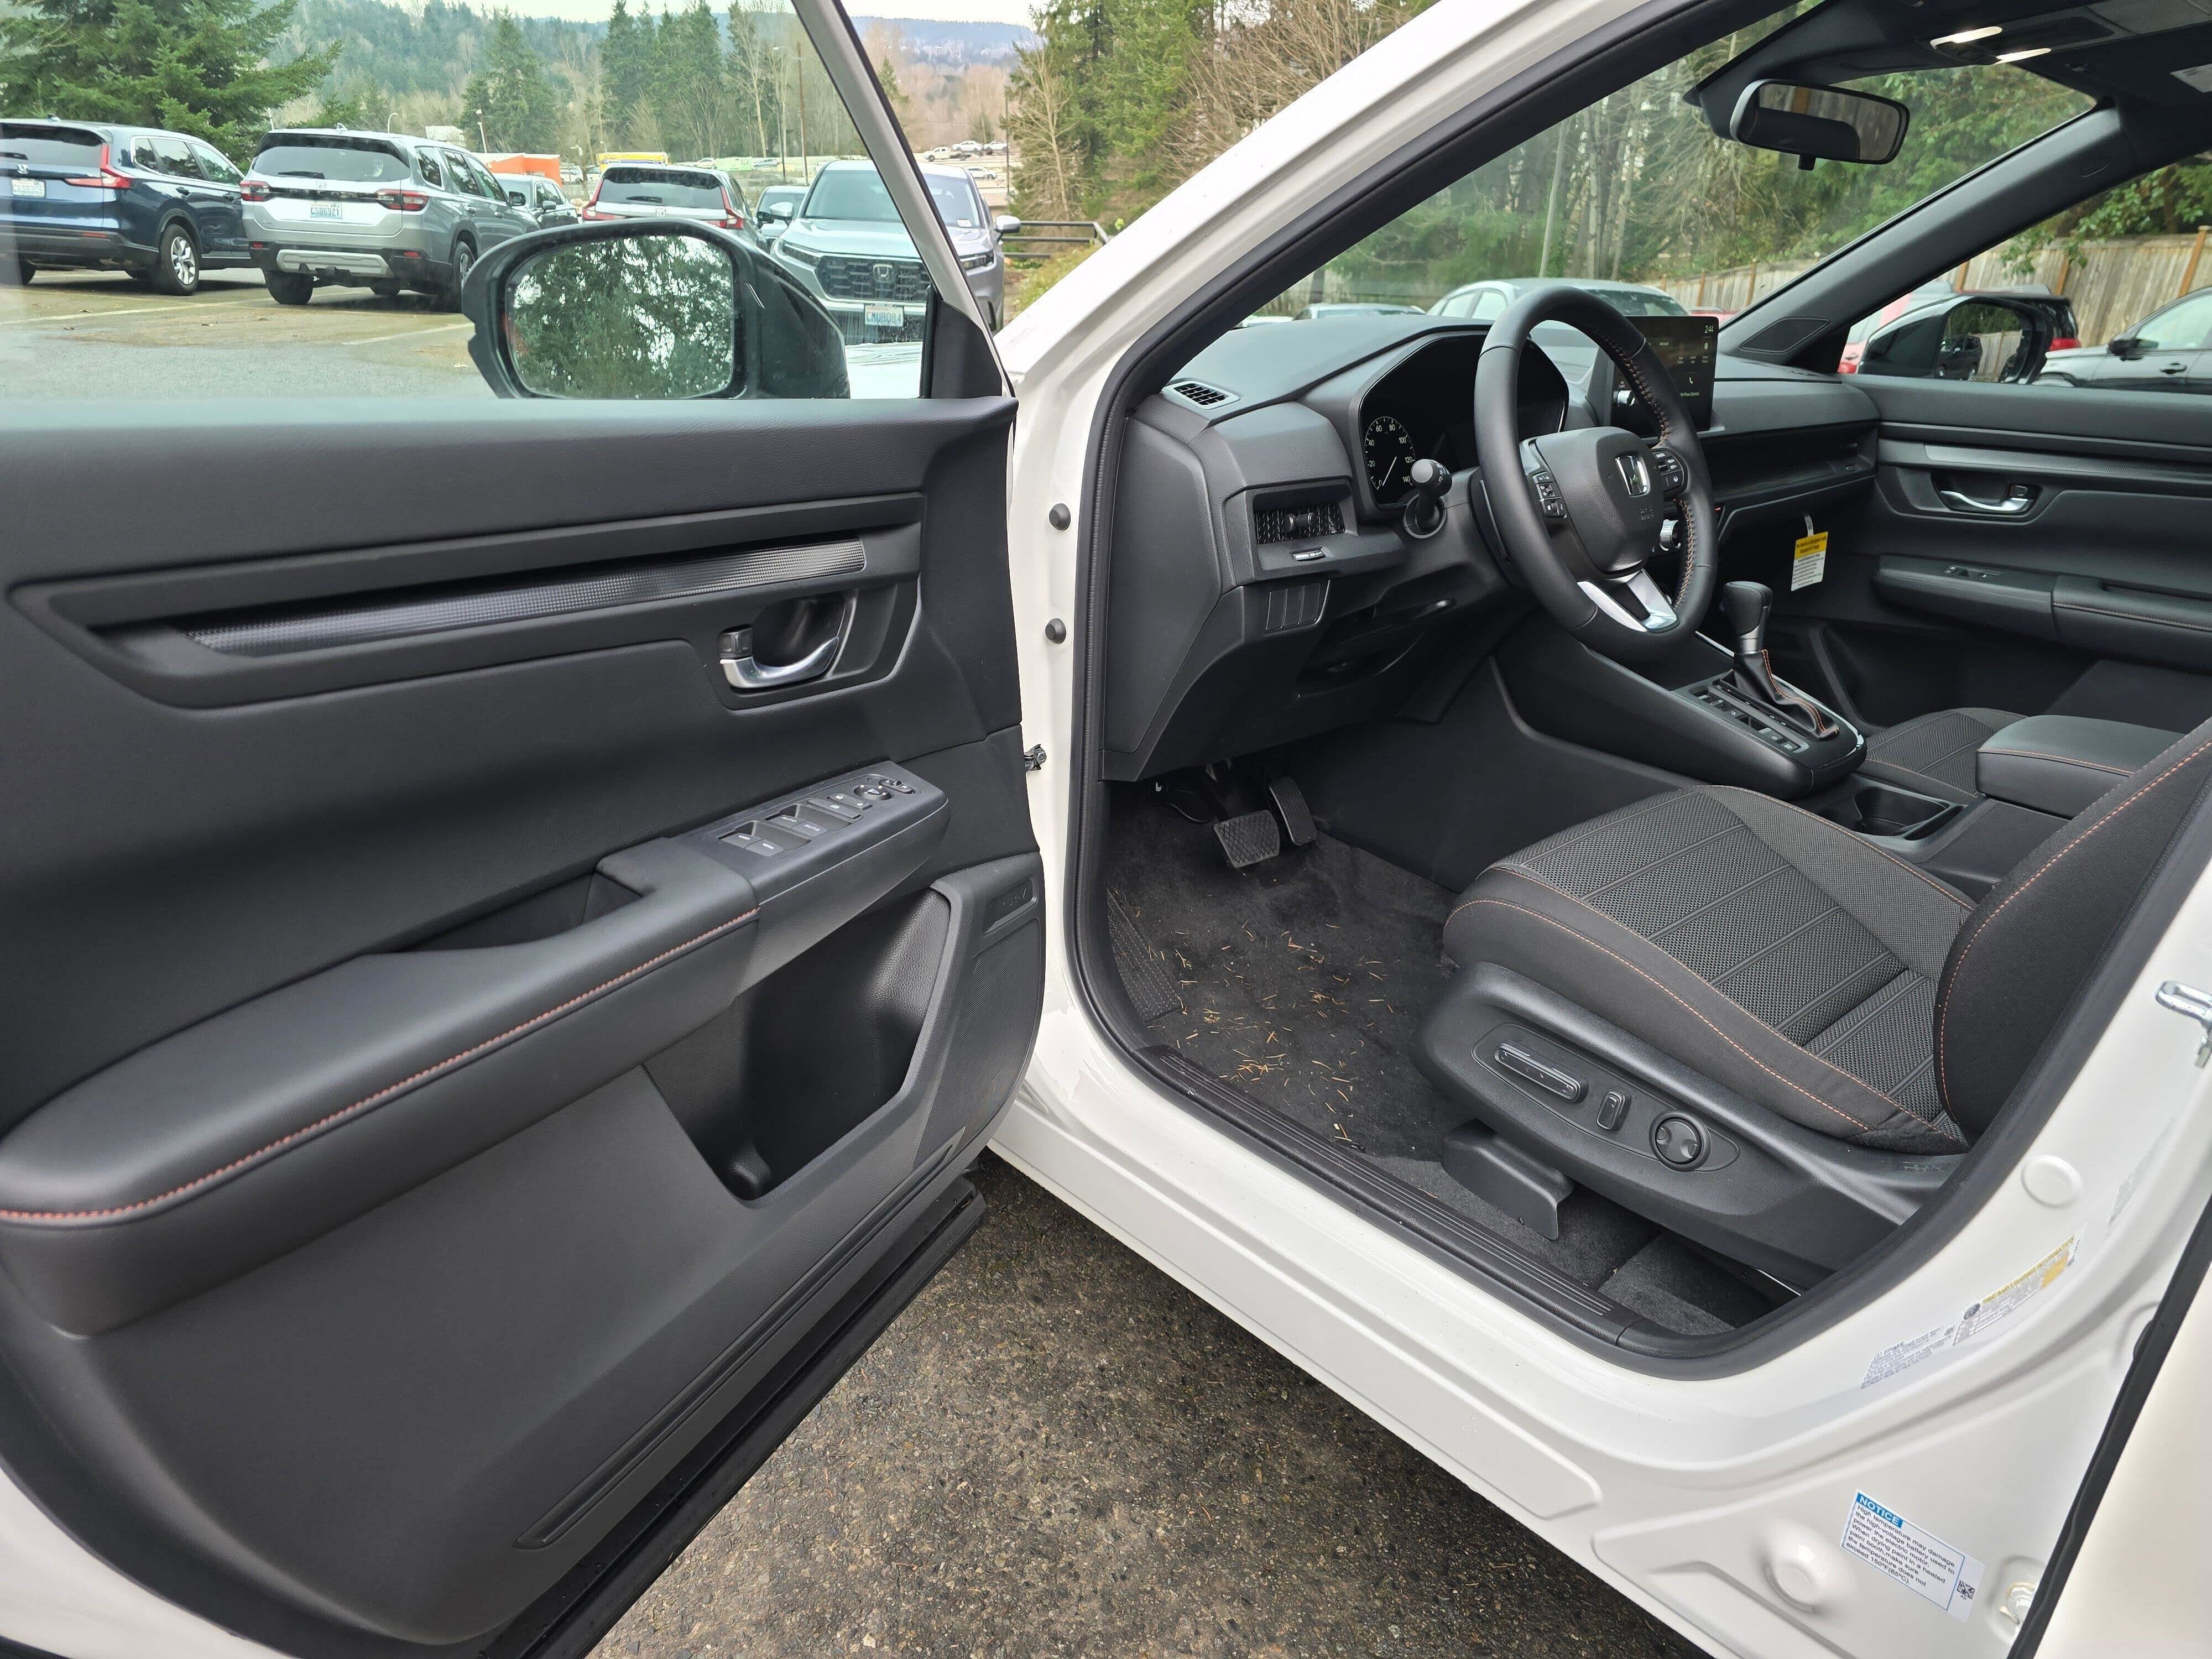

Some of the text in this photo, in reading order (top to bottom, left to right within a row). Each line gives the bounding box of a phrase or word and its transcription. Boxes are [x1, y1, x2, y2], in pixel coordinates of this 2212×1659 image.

[311, 207, 339, 216] CSD6921
[1860, 1495, 1900, 1526] NOTICE
[1846, 1543, 1869, 1559] exceed
[1850, 1530, 1865, 1542] paint
[1904, 1564, 1919, 1574] sure
[1852, 1523, 1870, 1537] When
[1871, 1536, 1890, 1551] drying
[1891, 1549, 1908, 1561] paint
[1922, 1567, 1945, 1584] heated
[1853, 1518, 1929, 1567] power the electric motor.
[1855, 1511, 1865, 1520] the
[1866, 1518, 1905, 1545] high-voltage
[1906, 1542, 1928, 1559] battery
[1930, 1557, 1947, 1569] used
[1858, 1505, 1955, 1567] High temperature may damage
[1848, 1536, 1926, 1587] the temperature does not
